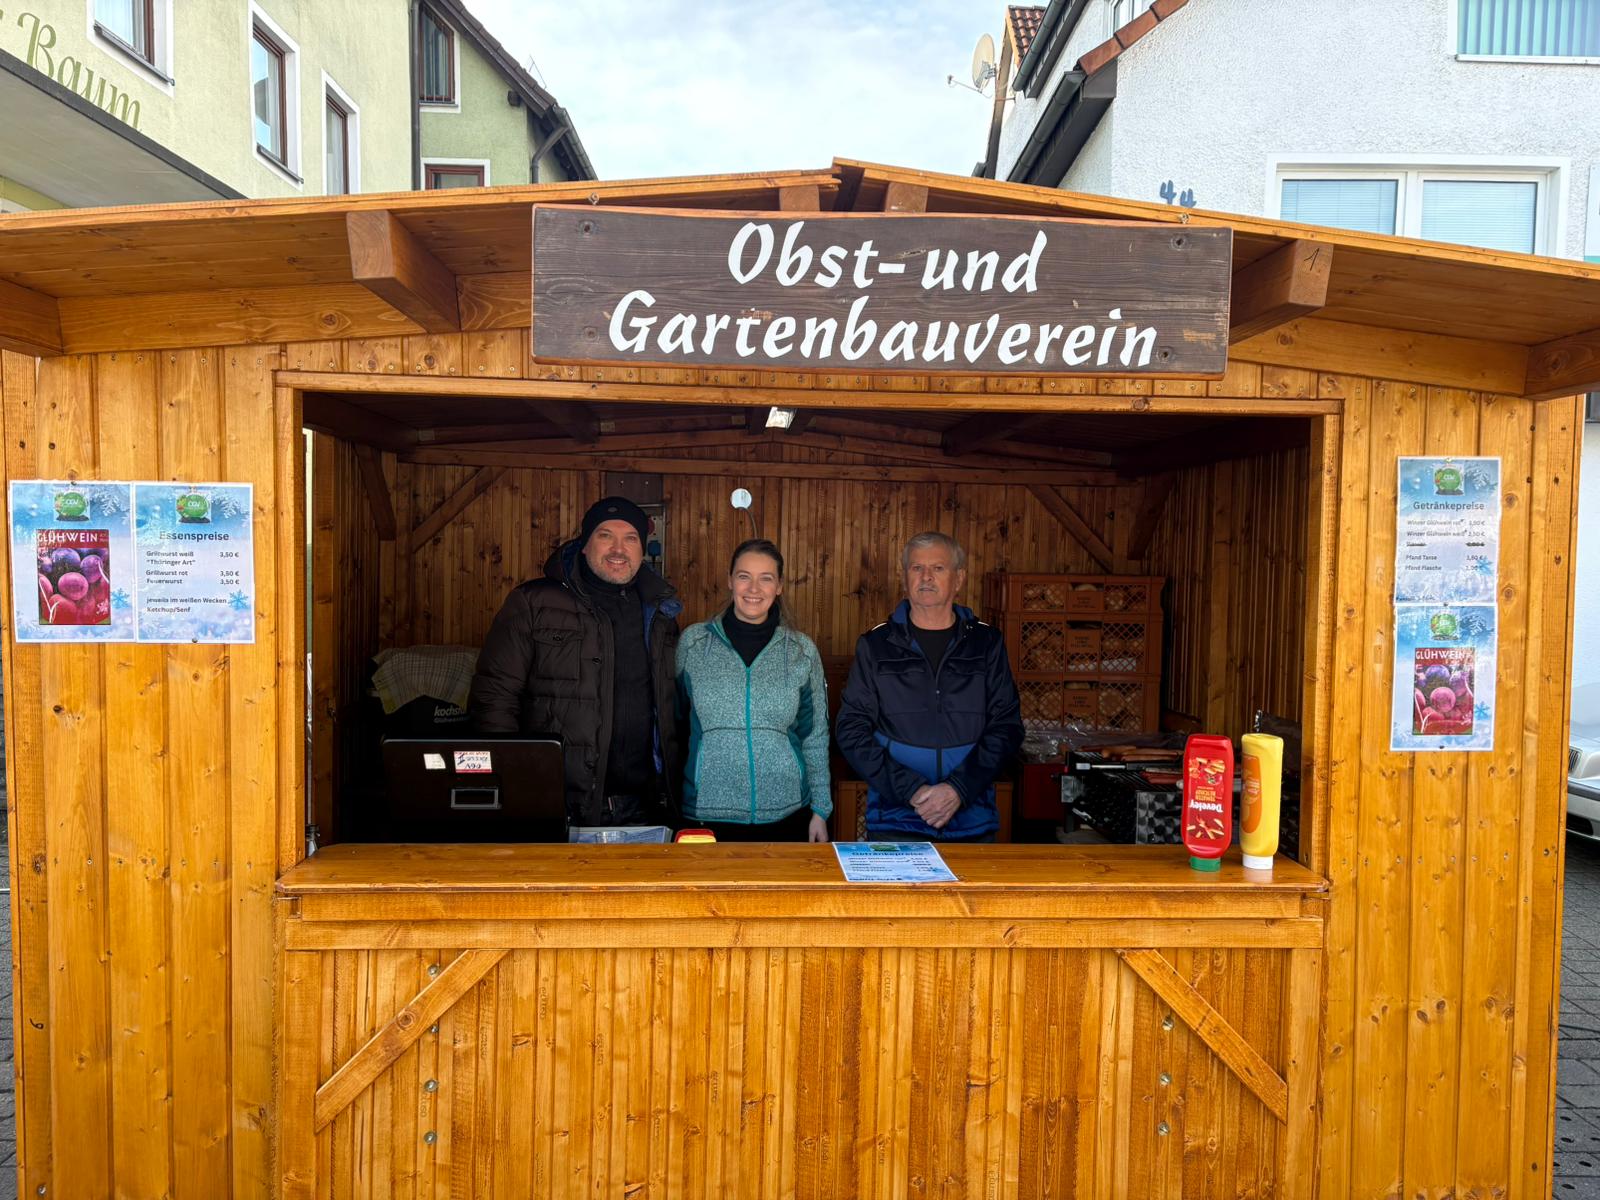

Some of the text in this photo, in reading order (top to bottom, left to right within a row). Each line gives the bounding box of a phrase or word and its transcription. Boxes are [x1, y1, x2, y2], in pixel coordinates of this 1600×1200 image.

[17, 12, 141, 132] Baum
[728, 221, 1048, 293] Obst- und
[609, 289, 1158, 368] Gartenbauverein
[1413, 501, 1485, 512] Getränkepreise
[37, 530, 98, 543] GLÜHWEIN
[159, 532, 230, 543] Essenspreise
[146, 606, 191, 614] Ketchup/Senf
[1415, 648, 1465, 660] GLÜHWEIN
[1189, 798, 1224, 813] Develey
